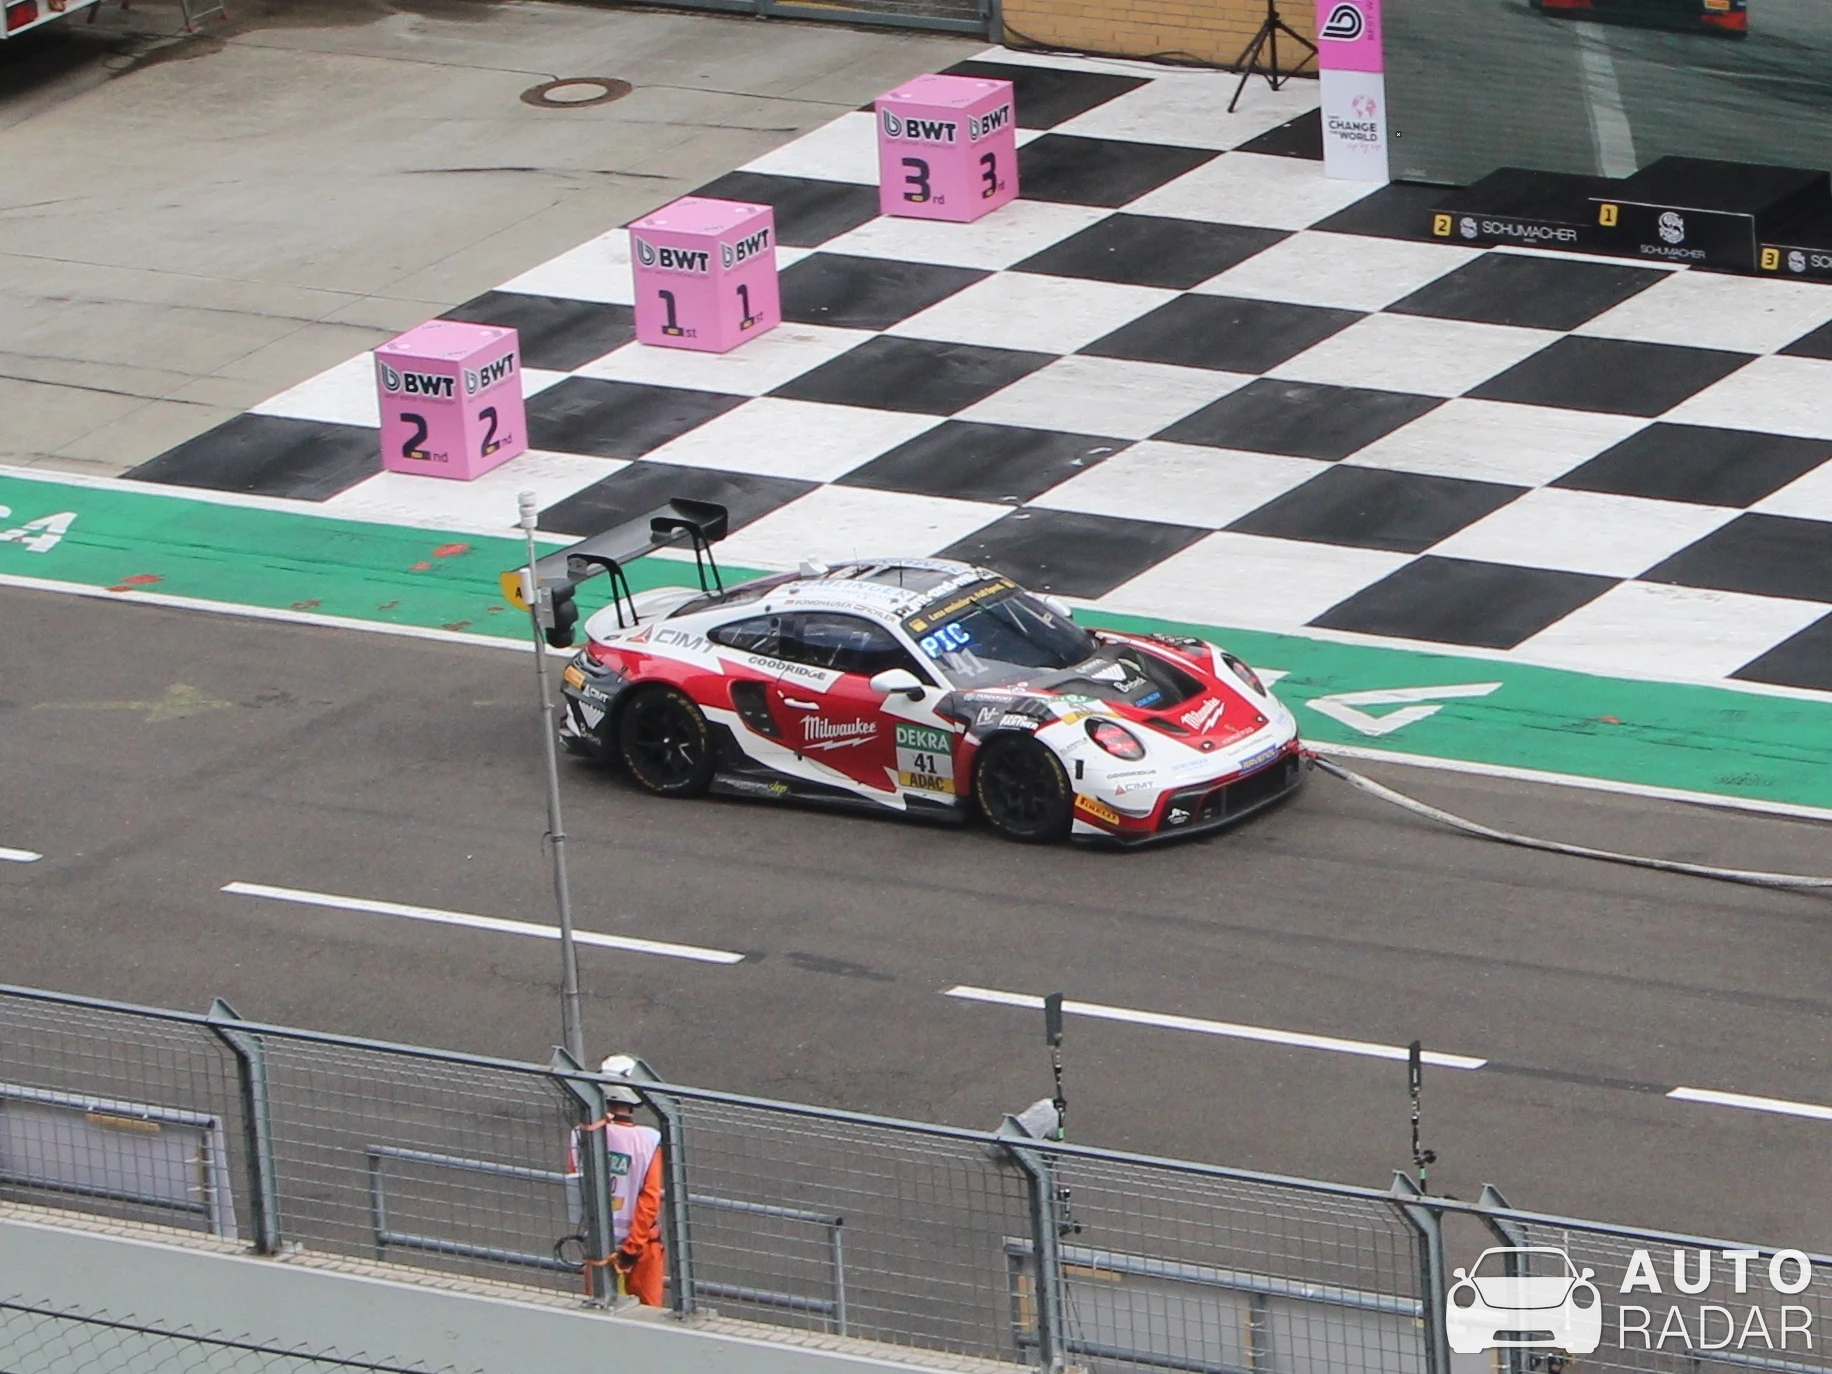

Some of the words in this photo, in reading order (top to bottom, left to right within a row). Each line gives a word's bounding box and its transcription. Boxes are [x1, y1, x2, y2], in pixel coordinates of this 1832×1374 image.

[906, 119, 957, 142] BWT
[982, 105, 1010, 135] BWT
[1328, 120, 1377, 133] CHANGE
[1339, 131, 1378, 142] WORLD
[1482, 220, 1577, 242] SCHUMACHER
[736, 228, 770, 262] BWT
[1640, 244, 1706, 259] SCHUMACHER
[659, 248, 709, 271] BWT
[480, 353, 515, 388] BWT
[404, 373, 454, 397] BWT
[653, 629, 719, 654] CIMT
[921, 622, 971, 659] PIC
[748, 656, 828, 680] GOODRIDGE
[942, 648, 990, 678] 41
[1181, 697, 1221, 730] Milwaukee
[800, 715, 878, 741] Milwaukee
[896, 728, 951, 752] DEKRA
[914, 753, 938, 774] 41
[909, 773, 945, 791] ADAC
[1125, 781, 1155, 792] CIMT
[1080, 797, 1117, 820] PIRELLI
